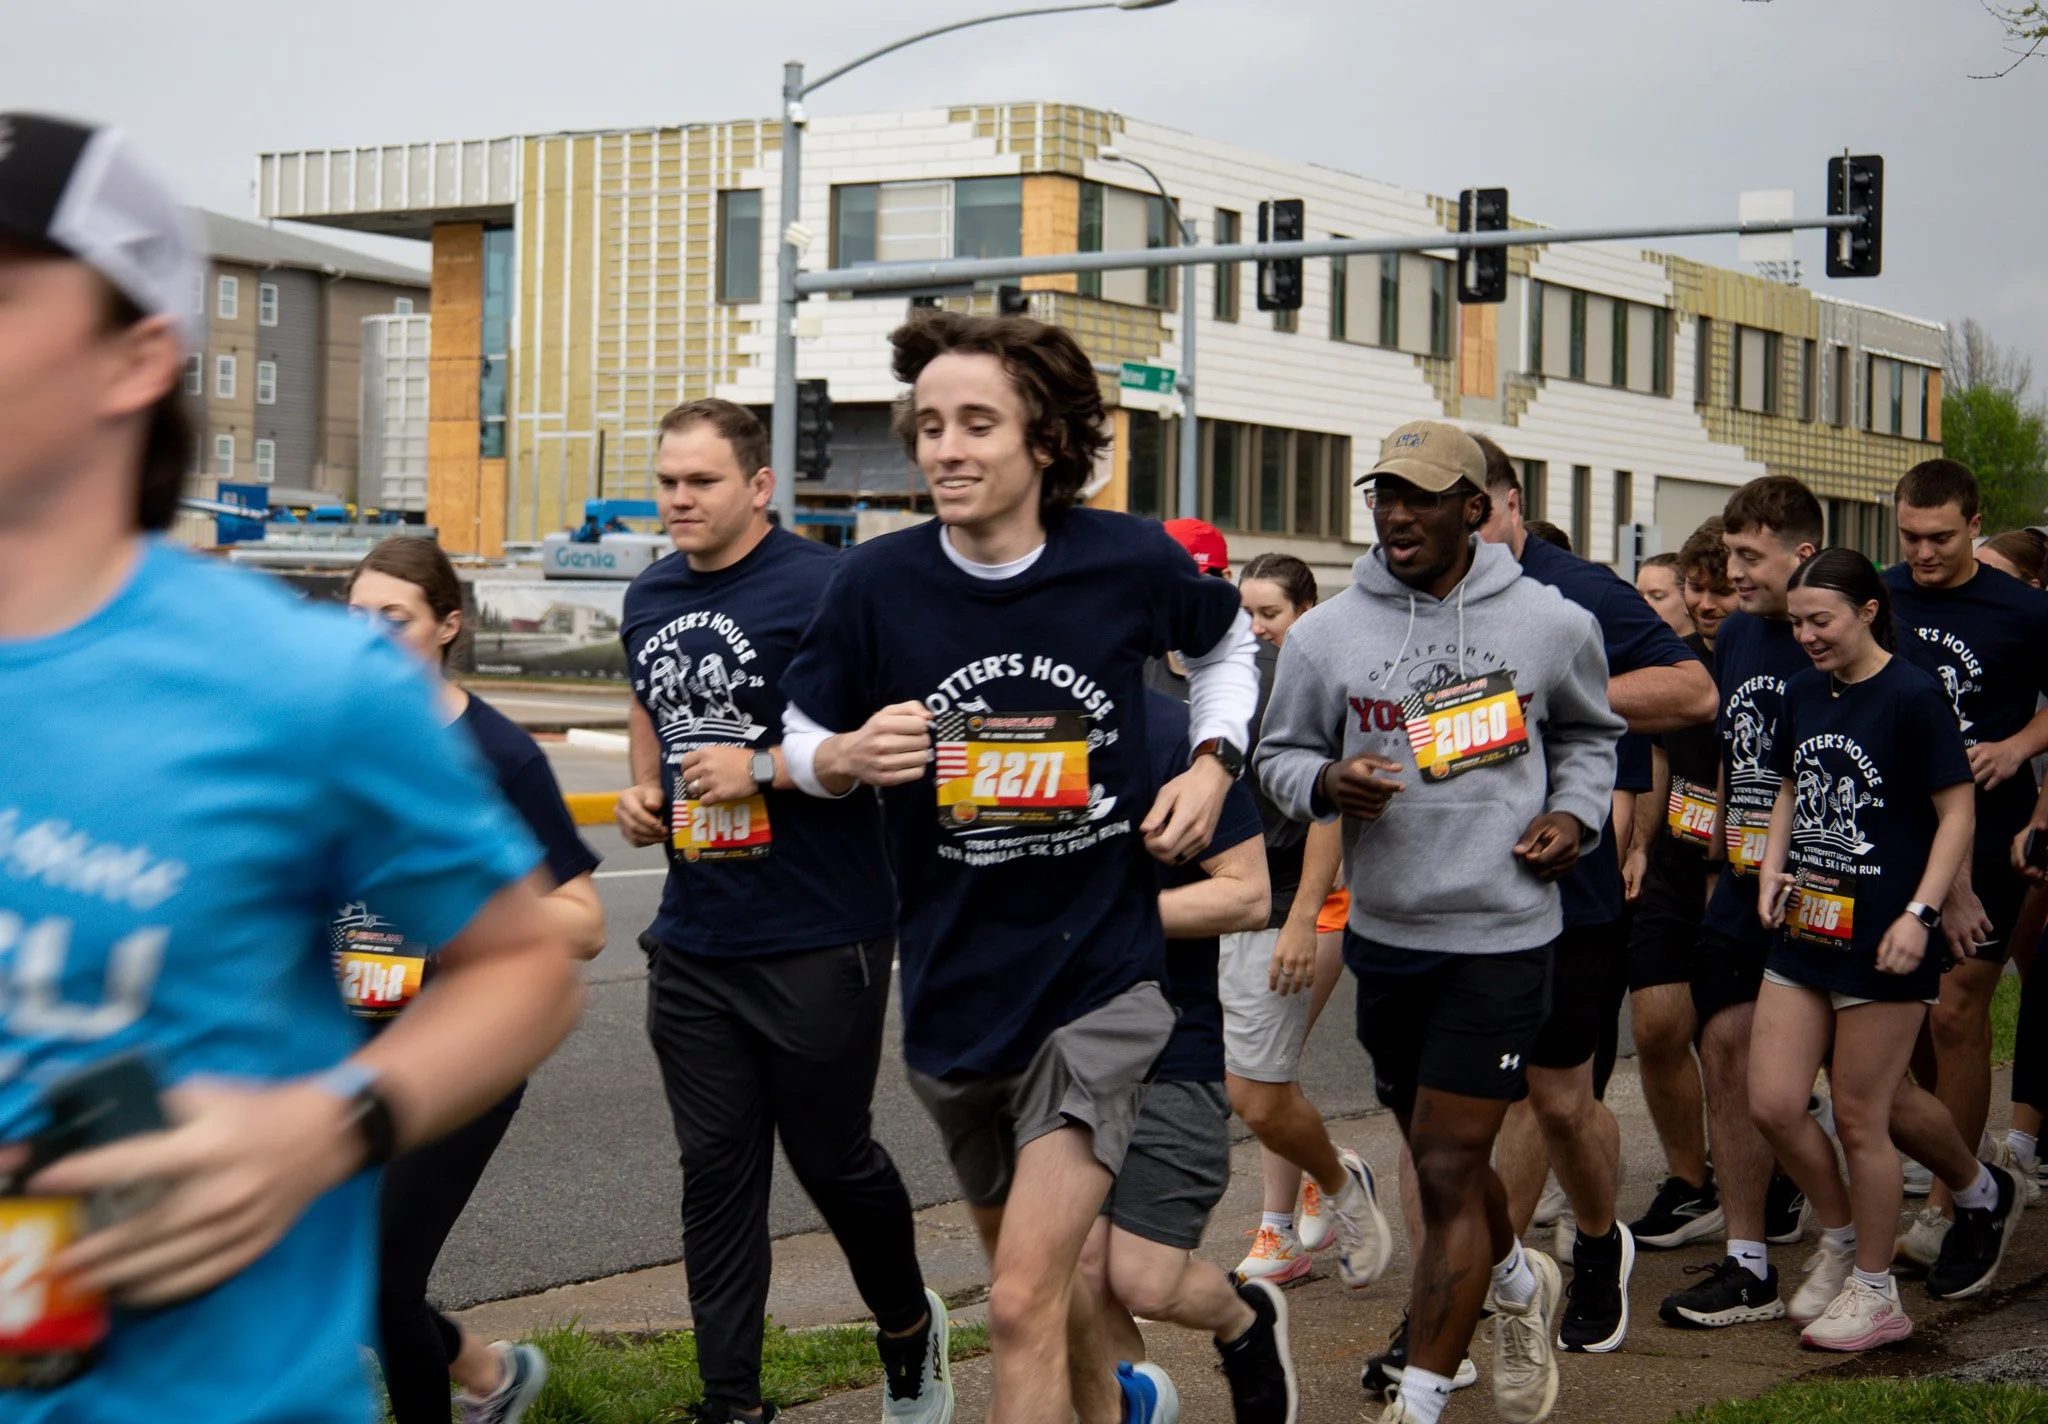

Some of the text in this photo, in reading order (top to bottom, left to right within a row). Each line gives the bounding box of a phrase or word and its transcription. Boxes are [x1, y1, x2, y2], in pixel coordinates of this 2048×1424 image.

[555, 547, 617, 568] Genie
[637, 611, 758, 666] POTTER'S HOUSE
[1942, 632, 1983, 678] HOUSE
[749, 675, 765, 687] 26
[925, 653, 1115, 721] OTTER'S HOUSE
[1726, 675, 1775, 718] POTTER'S
[1434, 701, 1508, 757] 2060
[971, 751, 1064, 798] 2271
[1844, 738, 1883, 788] HOUSE
[1872, 798, 1884, 807] 26
[690, 804, 750, 843] 2149
[1052, 843, 1066, 857] &
[1067, 832, 1097, 854] FUN
[1098, 819, 1132, 841] RUN
[1741, 832, 1767, 861] 20
[1841, 862, 1857, 875] FUN
[1859, 865, 1881, 875] RUN
[1799, 894, 1842, 931] 2136
[342, 960, 407, 1002] 2148
